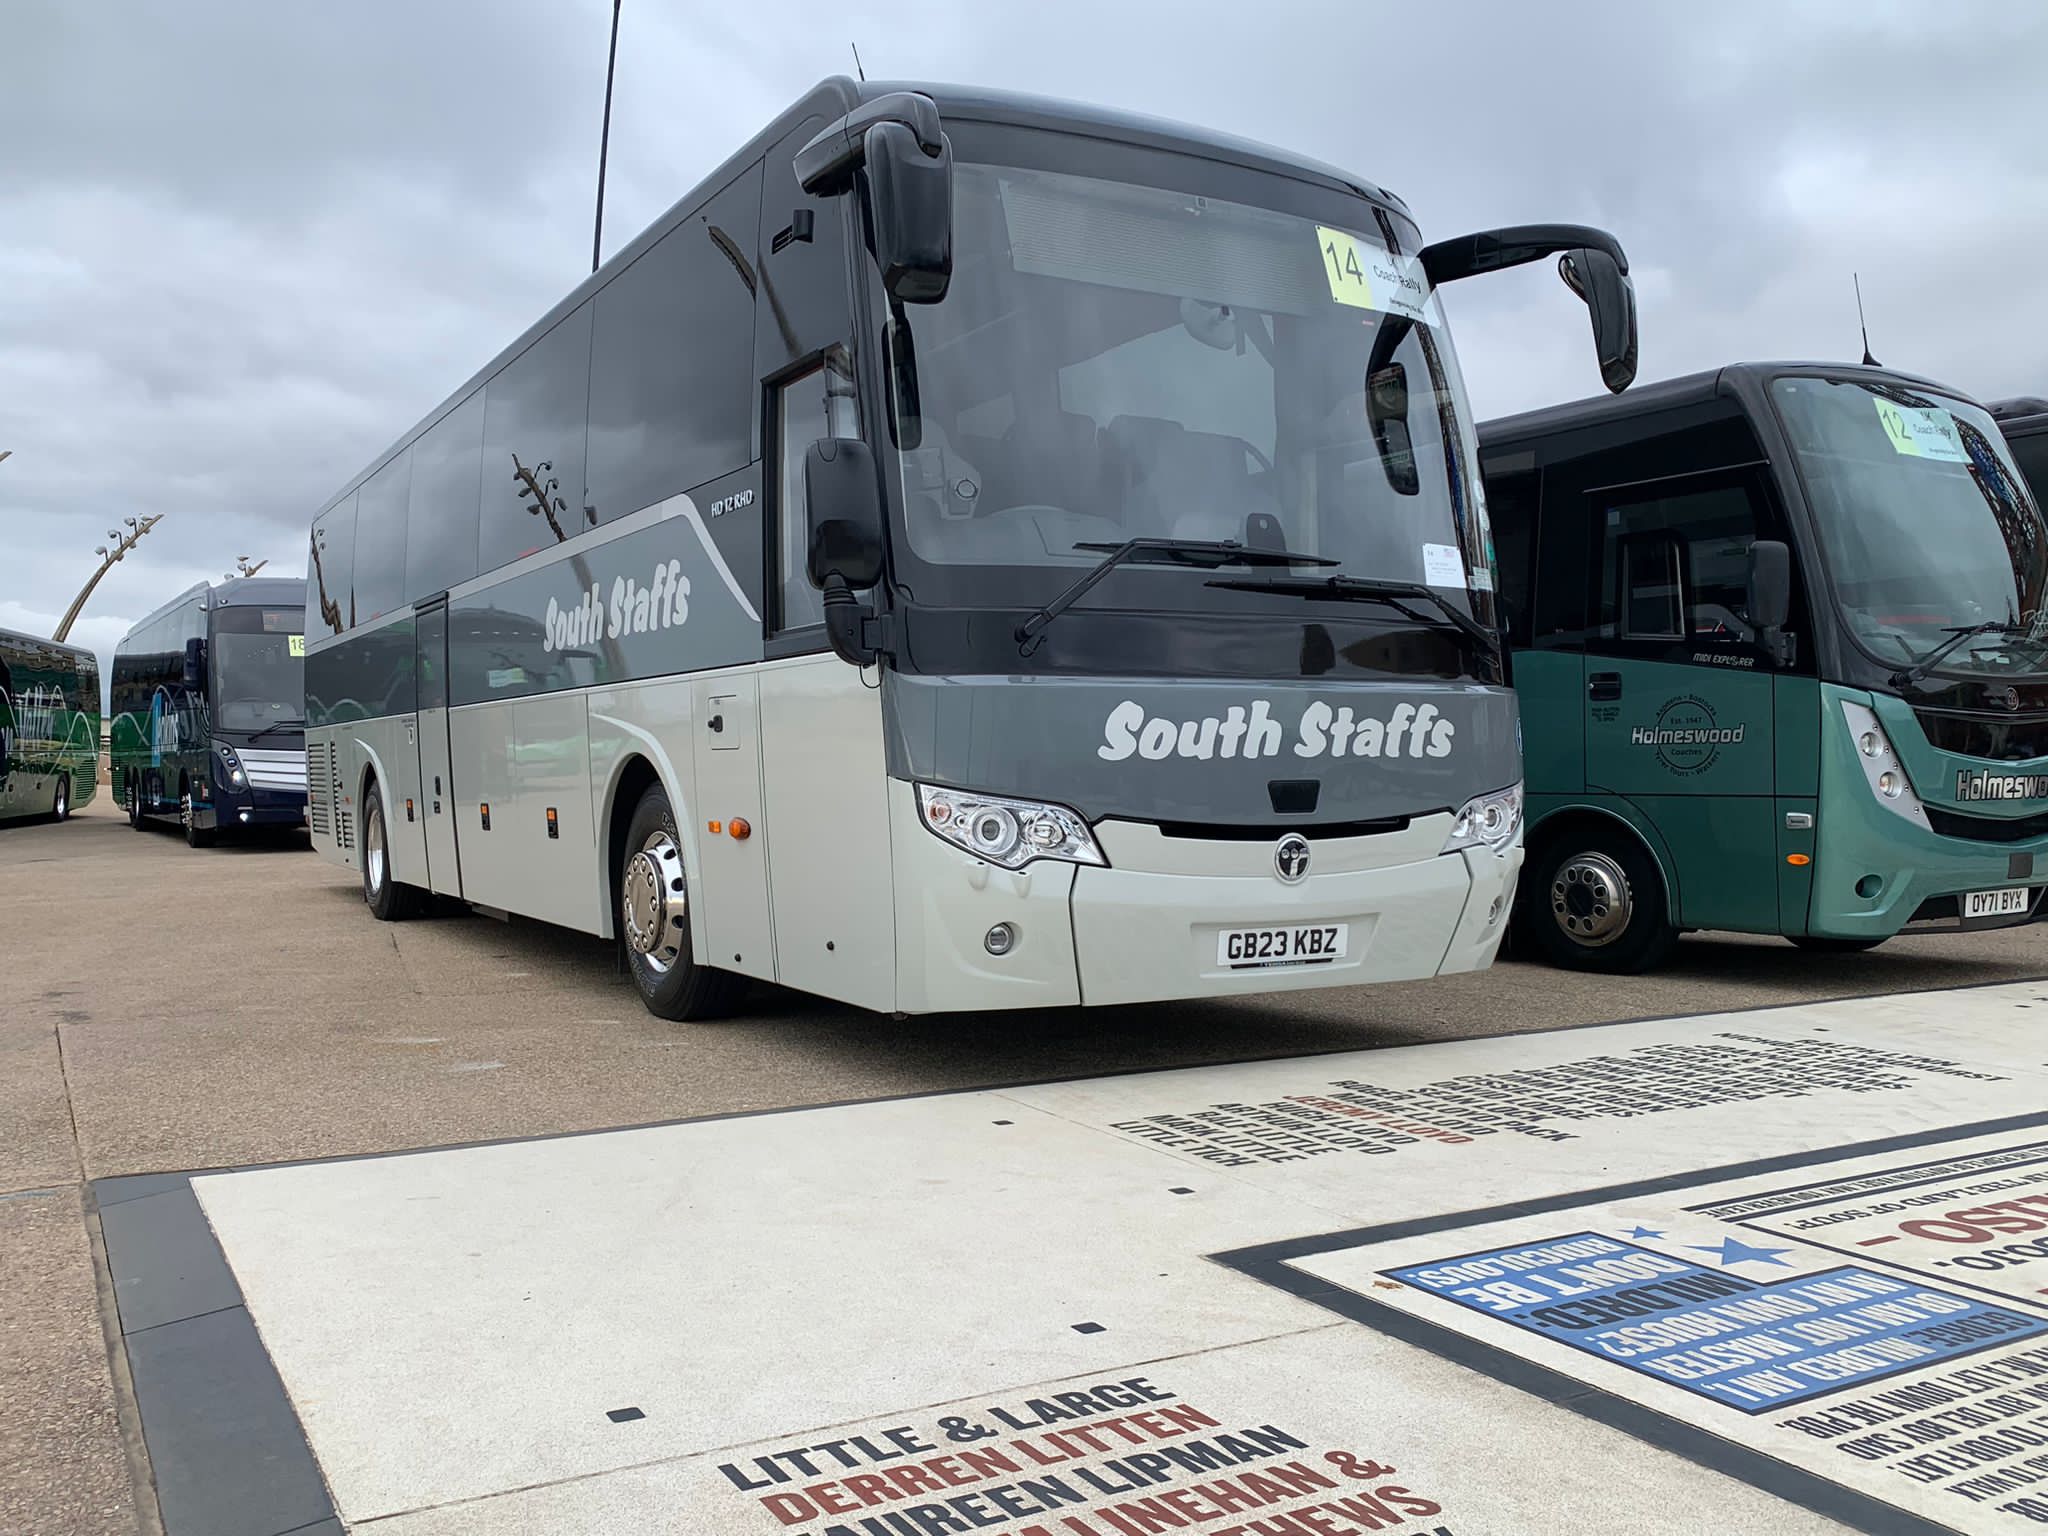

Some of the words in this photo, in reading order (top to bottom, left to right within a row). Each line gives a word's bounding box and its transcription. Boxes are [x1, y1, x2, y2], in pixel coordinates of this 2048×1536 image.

[1326, 242, 1363, 285] 14
[1882, 409, 1912, 440] 12
[711, 500, 724, 517] HD
[724, 496, 735, 513] 12
[735, 489, 753, 509] RHD
[543, 582, 604, 652] South
[607, 559, 691, 640] Staffs
[1713, 654, 1755, 667] EXPLORER
[1097, 700, 1283, 761] South
[1294, 700, 1455, 758] Staffs
[1631, 722, 1745, 745] Holmeswood
[1972, 892, 1999, 913] OY71
[2001, 890, 2022, 910] BYX
[1227, 931, 1288, 960] GB23
[1294, 928, 1338, 956] KBZ
[1326, 1080, 1420, 1100] ROGER
[1405, 1100, 1506, 1122] LLOYD
[1486, 1120, 1582, 1141] PACK
[1403, 1087, 1486, 1104] SEAN
[1467, 1102, 1558, 1122] LOCK
[1426, 1081, 1517, 1099] DAVID
[1498, 1097, 1605, 1120] LODGE
[1449, 1075, 1547, 1094] CISSIE
[1528, 1093, 1648, 1118] LOFTUS
[1207, 1102, 1319, 1130] ARTHUR
[1296, 1128, 1400, 1155] LLOYD
[1257, 1101, 1342, 1121] HUGH
[1322, 1120, 1423, 1144] LLOYD
[1279, 1093, 1393, 1121] JEREMY
[1373, 1119, 1479, 1144] LLOYD
[1324, 1092, 1419, 1113] MARIE
[1399, 1112, 1503, 1135] LLOYD
[1106, 1120, 1201, 1146] LITTLE
[1177, 1145, 1258, 1166] TICH
[1140, 1114, 1227, 1136] MARK
[1203, 1134, 1307, 1163] LITTLE
[1185, 1111, 1262, 1129] RALF
[1240, 1128, 1343, 1155] LITTLE
[1784, 1208, 1873, 1230] SOUP!
[1405, 1238, 1627, 1288] RIDICULOUS!
[1527, 1253, 1691, 1297] DON'T
[1452, 1280, 1553, 1310] BE
[1783, 1282, 1873, 1306] MY
[1832, 1273, 1909, 1294] IN
[1512, 1275, 1753, 1331] MILDRED:
[1708, 1294, 1821, 1324] OWN
[1850, 1302, 1931, 1325] AM
[1889, 1292, 1973, 1315] OR
[1579, 1312, 1740, 1354] HOUSE?
[1763, 1316, 1870, 1347] NOT,
[1833, 1313, 1888, 1330] I
[1900, 1312, 2034, 1348] GEORGE:
[1641, 1334, 1803, 1379] MASTER
[1773, 1336, 1934, 1381] MILDRED,
[1988, 1356, 2048, 1376] ME
[1725, 1370, 1808, 1396] AM
[1933, 1369, 2009, 1393] LIFT
[1973, 1365, 2024, 1381] A
[1698, 1381, 1760, 1402] I,
[1870, 1381, 1968, 1412] DOWN
[1972, 1394, 2042, 1416] BUT
[1774, 1411, 1863, 1441] PUB.
[1826, 1399, 1906, 1425] THE
[1929, 1407, 2000, 1430] DEL
[718, 1426, 936, 1490] LITTLE
[927, 1413, 1000, 1444] &
[988, 1377, 1175, 1430] LARGE
[1887, 1419, 1961, 1443] BOY
[1994, 1425, 2048, 1446] TO
[1076, 1425, 1305, 1494] LIPMAN
[1834, 1433, 1916, 1461] SAID
[1946, 1434, 2027, 1462] OUR
[761, 1448, 1020, 1524] DERREN
[1012, 1405, 1220, 1464] LITTEN
[1324, 1450, 1396, 1479] &
[1886, 1450, 1980, 1482] FLAT!
[1995, 1464, 2048, 1483] TO
[1943, 1473, 2022, 1501] WALK
